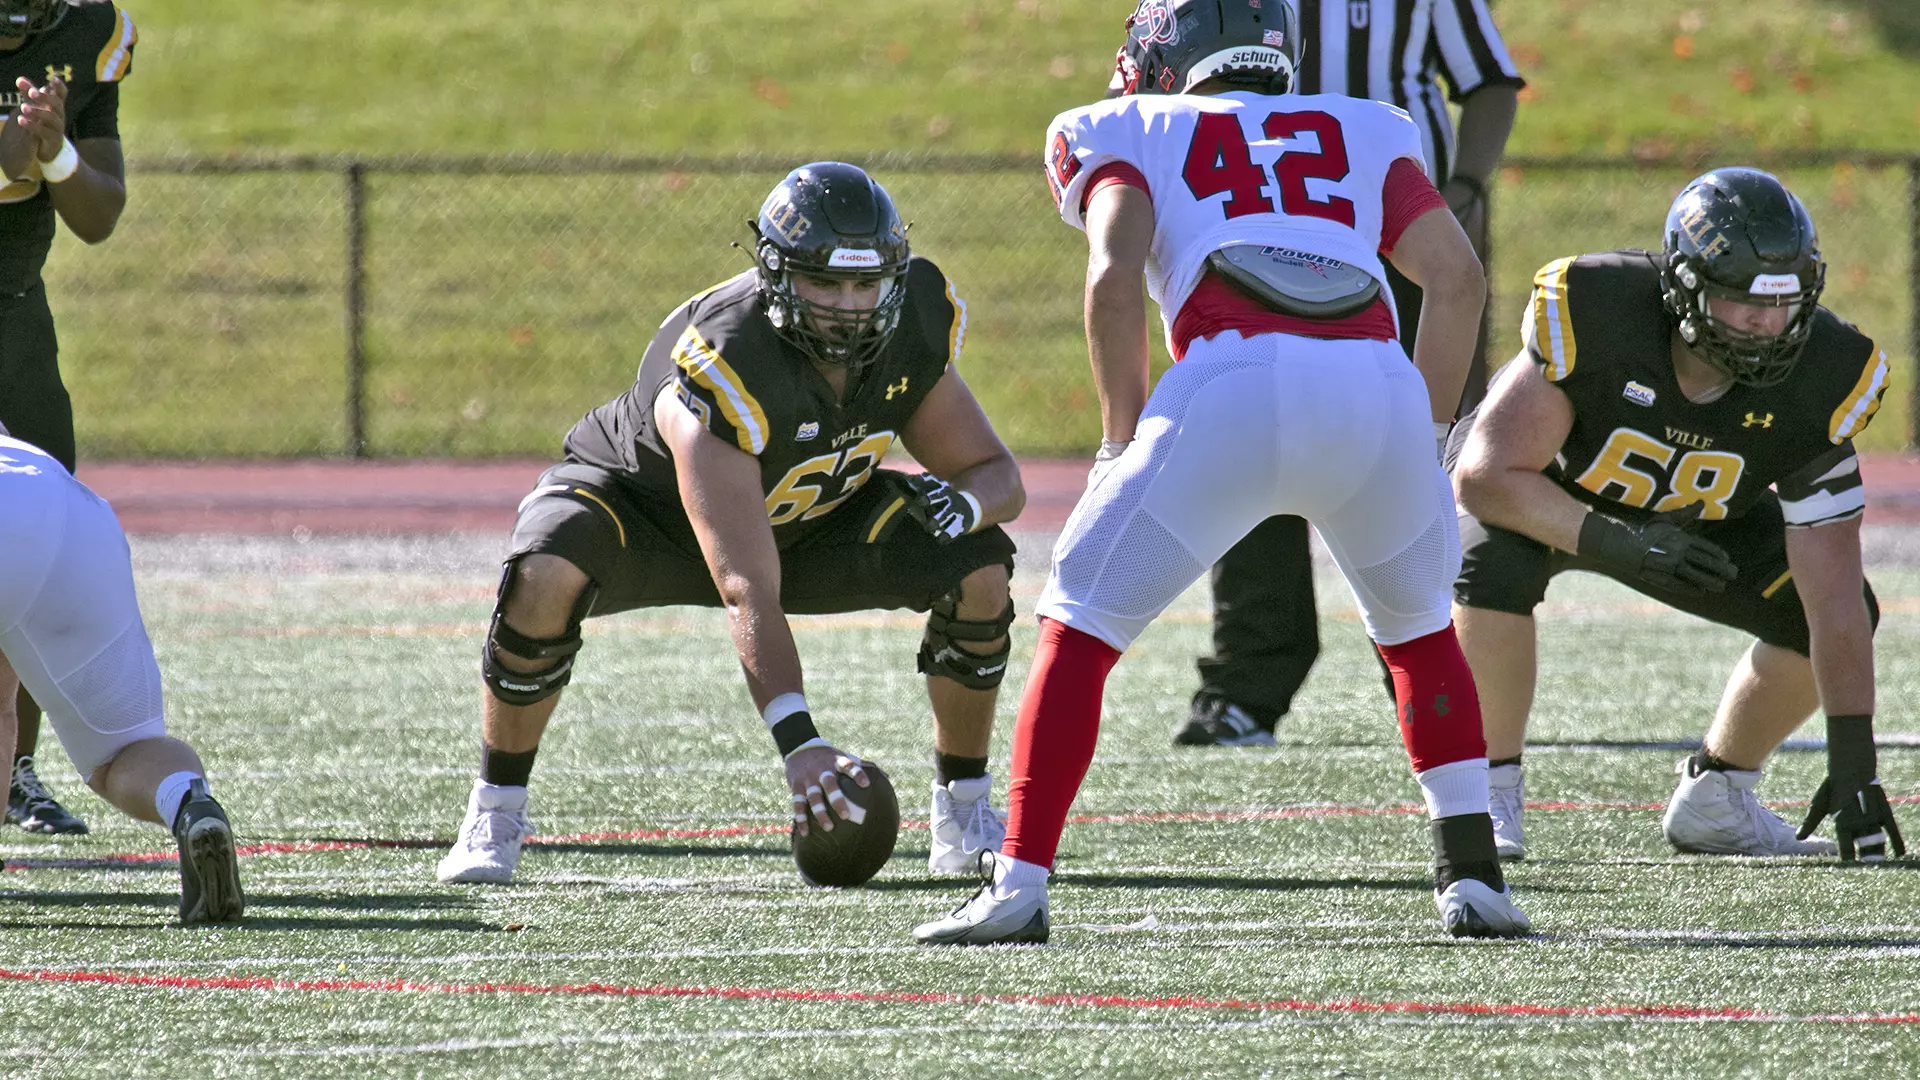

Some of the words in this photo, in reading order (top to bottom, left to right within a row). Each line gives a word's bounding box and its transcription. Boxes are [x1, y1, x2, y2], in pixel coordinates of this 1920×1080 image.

[1231, 50, 1280, 65] schutt
[1181, 110, 1356, 230] 42
[832, 423, 868, 449] VILLE
[1664, 426, 1714, 450] VILLE
[764, 430, 896, 527] 63
[1575, 427, 1746, 521] 68
